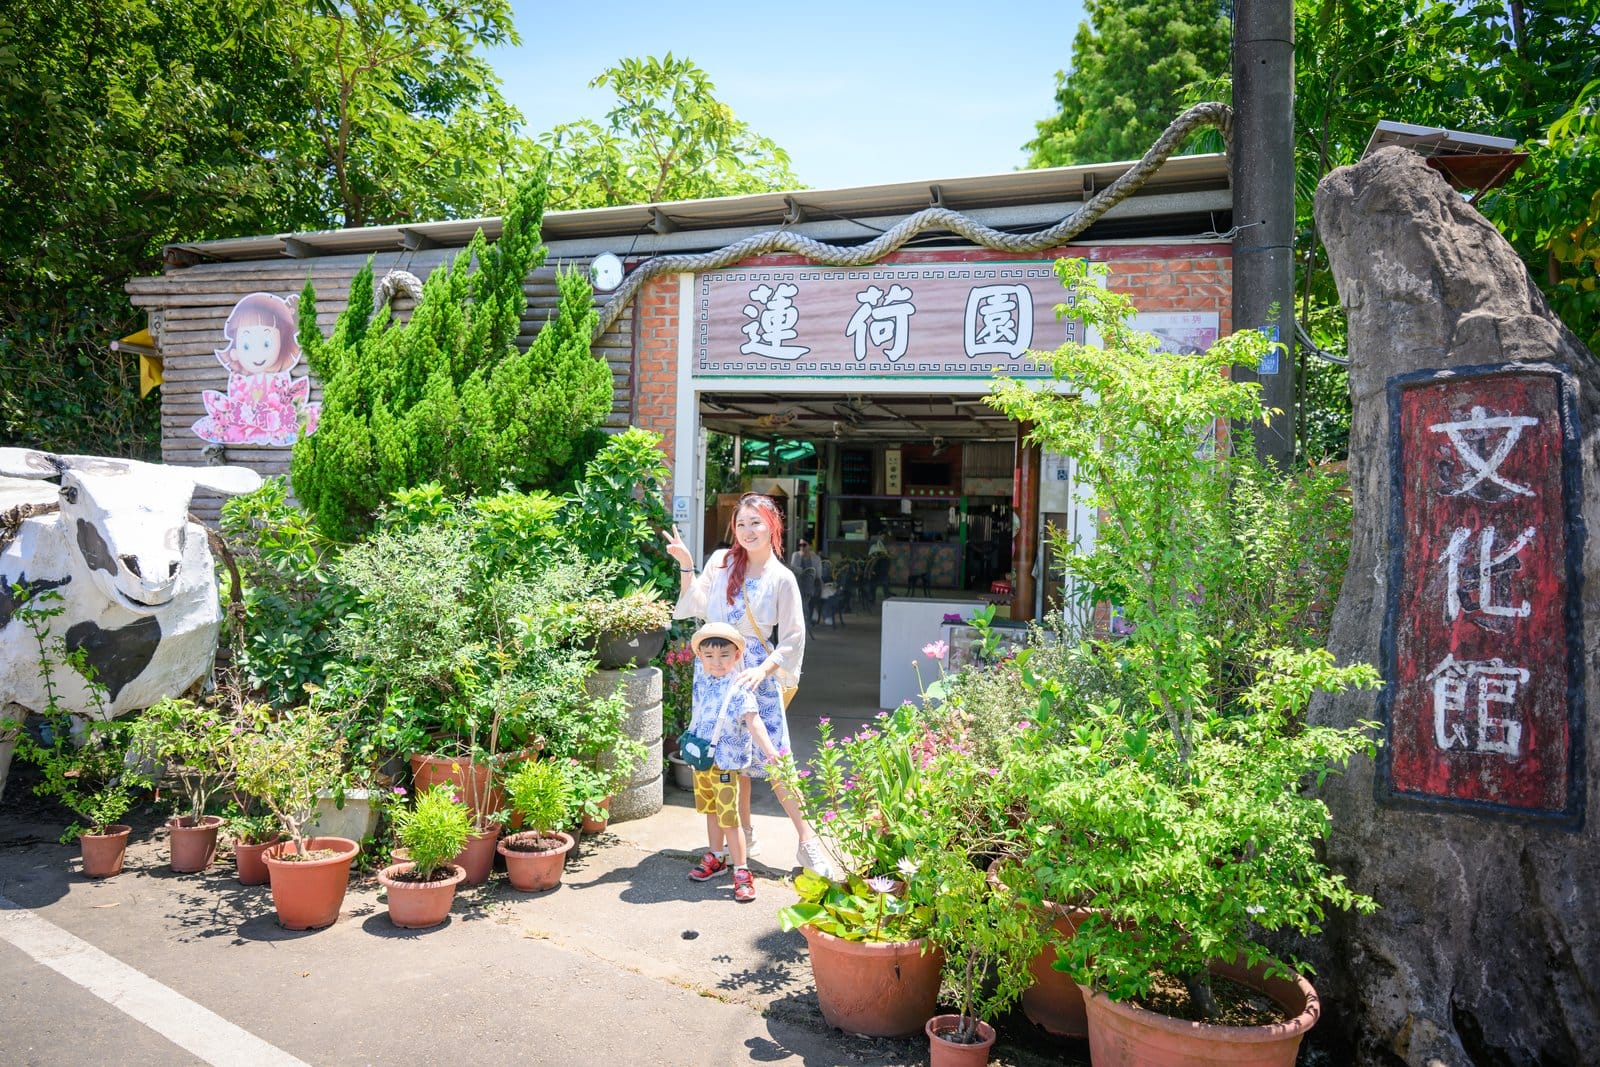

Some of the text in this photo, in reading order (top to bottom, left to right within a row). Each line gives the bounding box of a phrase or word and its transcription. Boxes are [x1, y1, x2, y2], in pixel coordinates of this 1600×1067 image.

[740, 283, 1033, 362] 蓮荷園
[1427, 406, 1539, 763] 文化館
